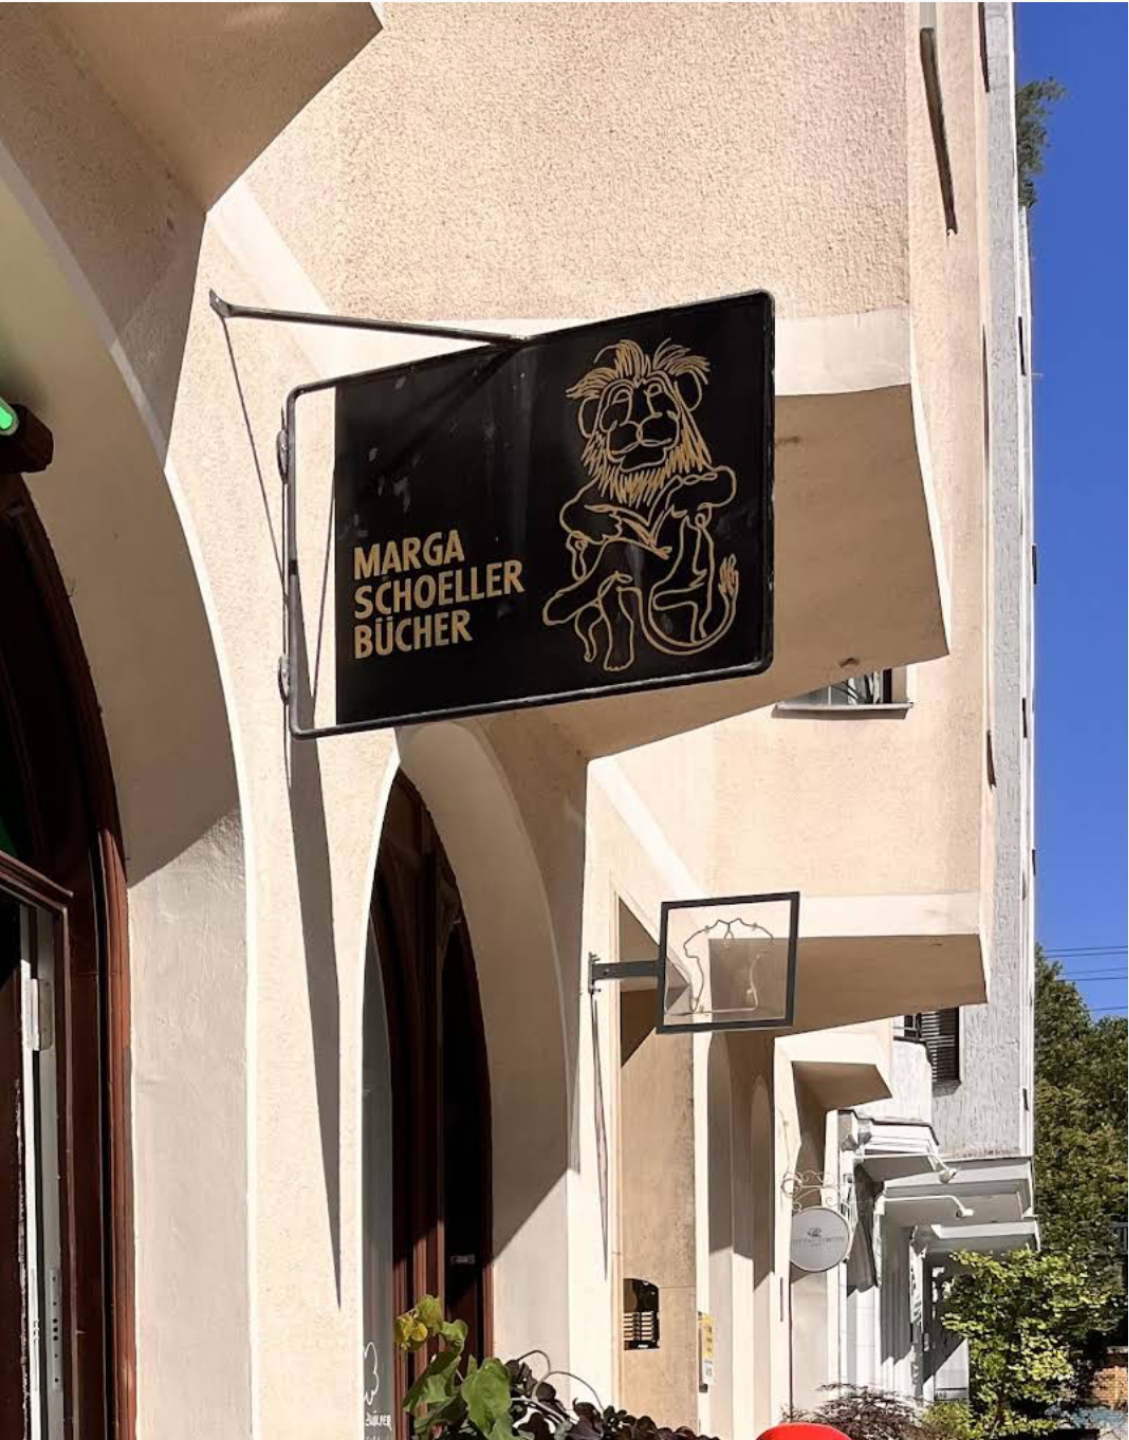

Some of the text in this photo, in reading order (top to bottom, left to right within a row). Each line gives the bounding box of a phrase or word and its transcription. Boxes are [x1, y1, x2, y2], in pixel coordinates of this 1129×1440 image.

[353, 529, 466, 581] MARGA
[353, 559, 526, 621] SCHOELLER
[353, 609, 473, 660] BÜCHER
